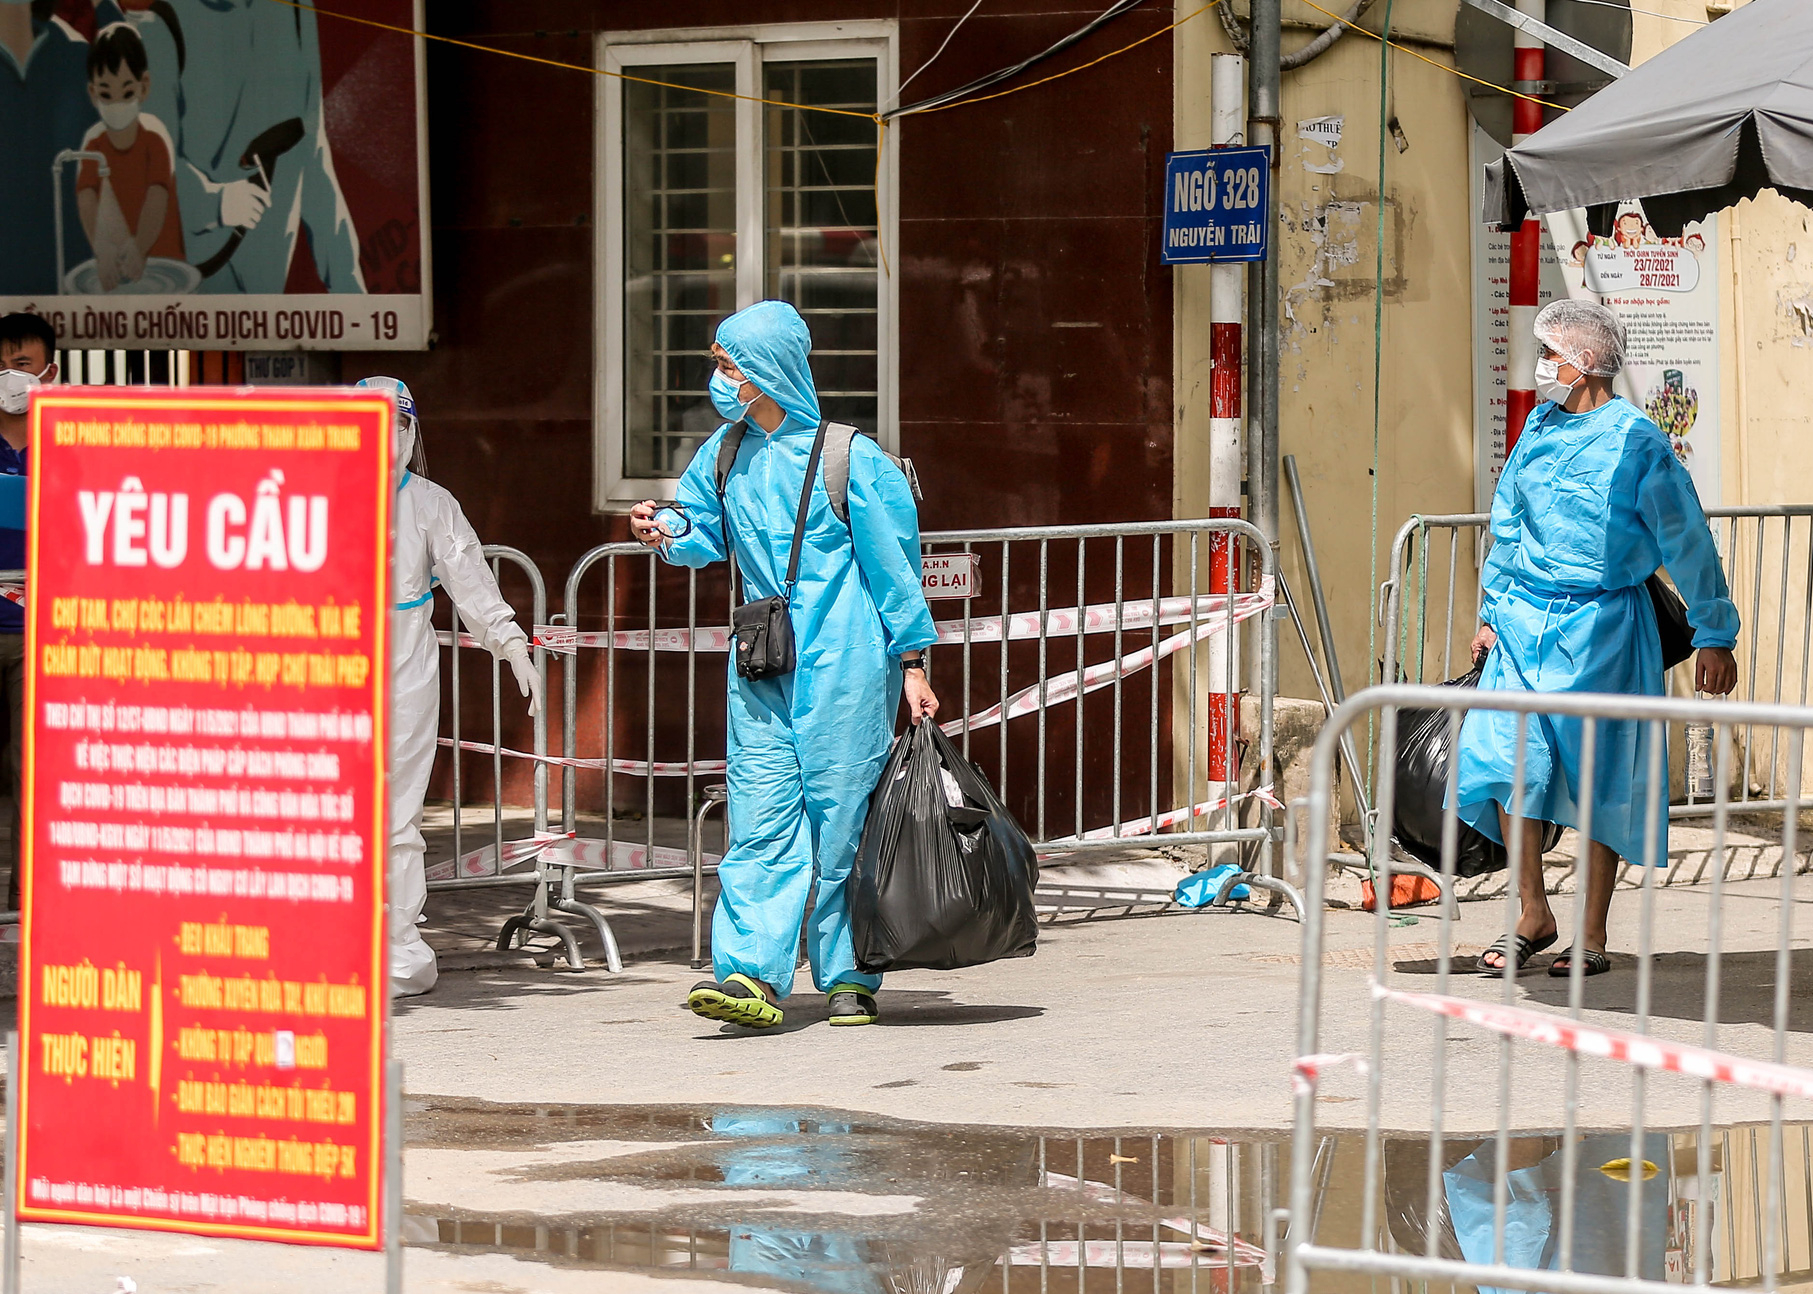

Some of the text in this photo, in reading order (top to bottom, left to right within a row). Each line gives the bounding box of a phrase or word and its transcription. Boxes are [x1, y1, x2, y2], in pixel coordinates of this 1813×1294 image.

[1174, 161, 1259, 213] NGÕ 328
[1169, 219, 1261, 247] NGUYỄN TRÃI
[1634, 259, 1674, 271] 23/7/2021
[1640, 274, 1680, 287] 28/7/2021
[73, 305, 128, 339] LÒNG
[134, 302, 208, 339] CHỐNG
[215, 310, 268, 345] DỊCH
[275, 310, 344, 340] COVID
[371, 311, 398, 340] 19
[77, 468, 329, 572] YÊU CẦU
[941, 573, 966, 589] LẠI
[42, 958, 142, 1012] NGƯỜI DÂN
[41, 1030, 136, 1088] THỰC HIỆN
